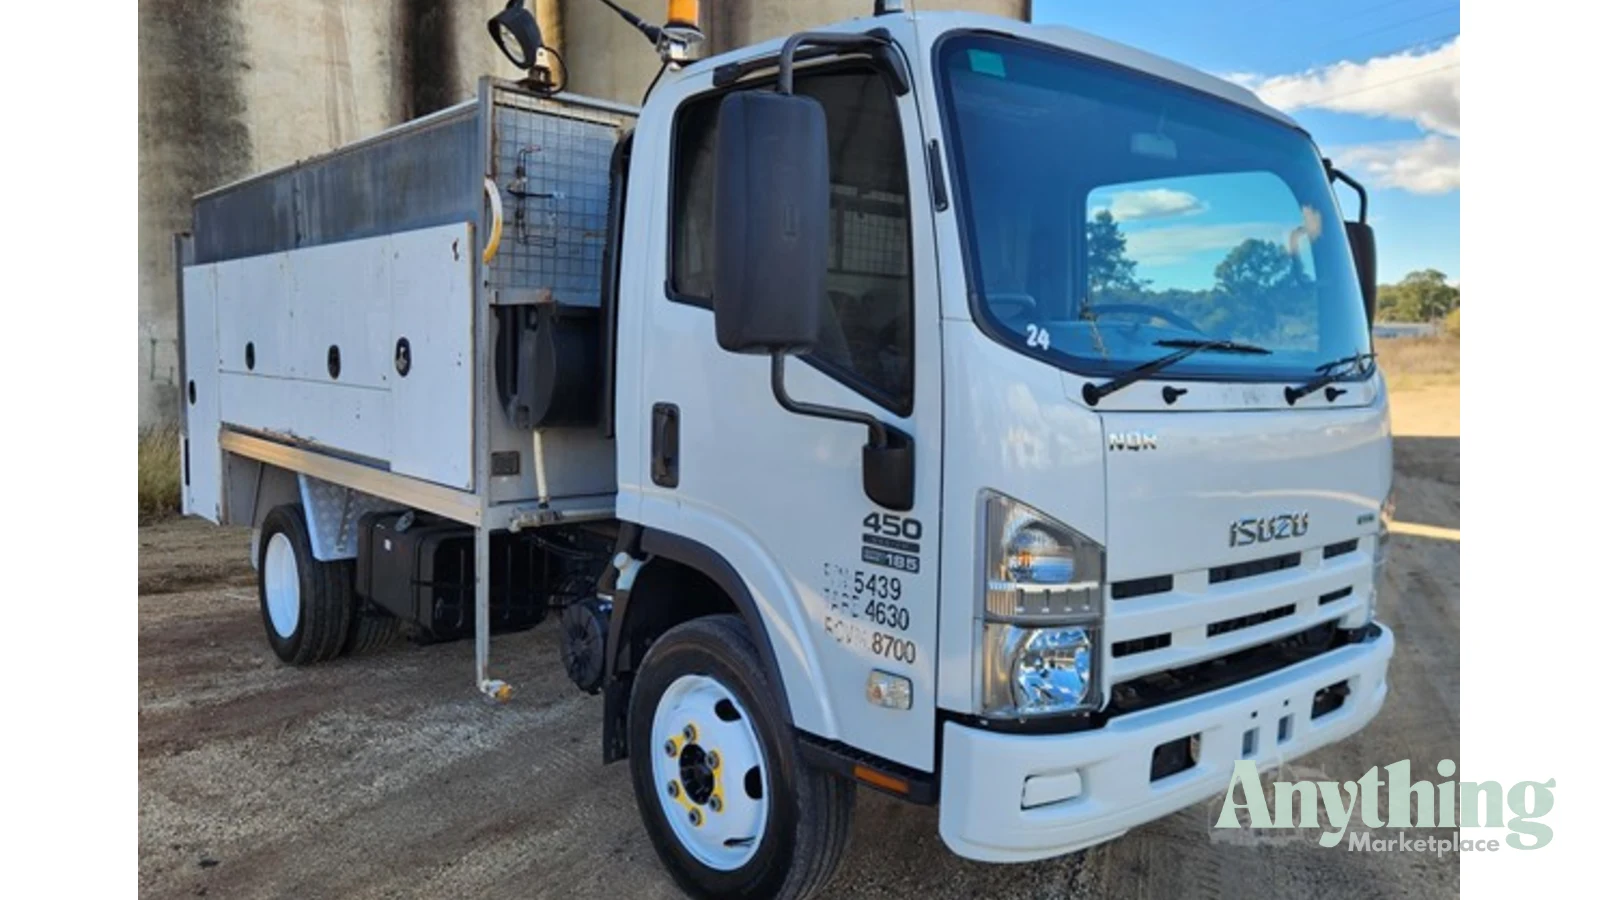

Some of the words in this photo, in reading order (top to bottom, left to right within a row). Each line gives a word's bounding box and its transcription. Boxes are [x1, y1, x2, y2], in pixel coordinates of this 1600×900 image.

[1026, 323, 1050, 350] 24
[863, 512, 922, 540] 450
[1229, 512, 1309, 548] ISUZU
[887, 553, 918, 571] 185
[854, 571, 901, 600] 5439
[865, 600, 909, 631] 4630
[871, 632, 916, 664] 8700
